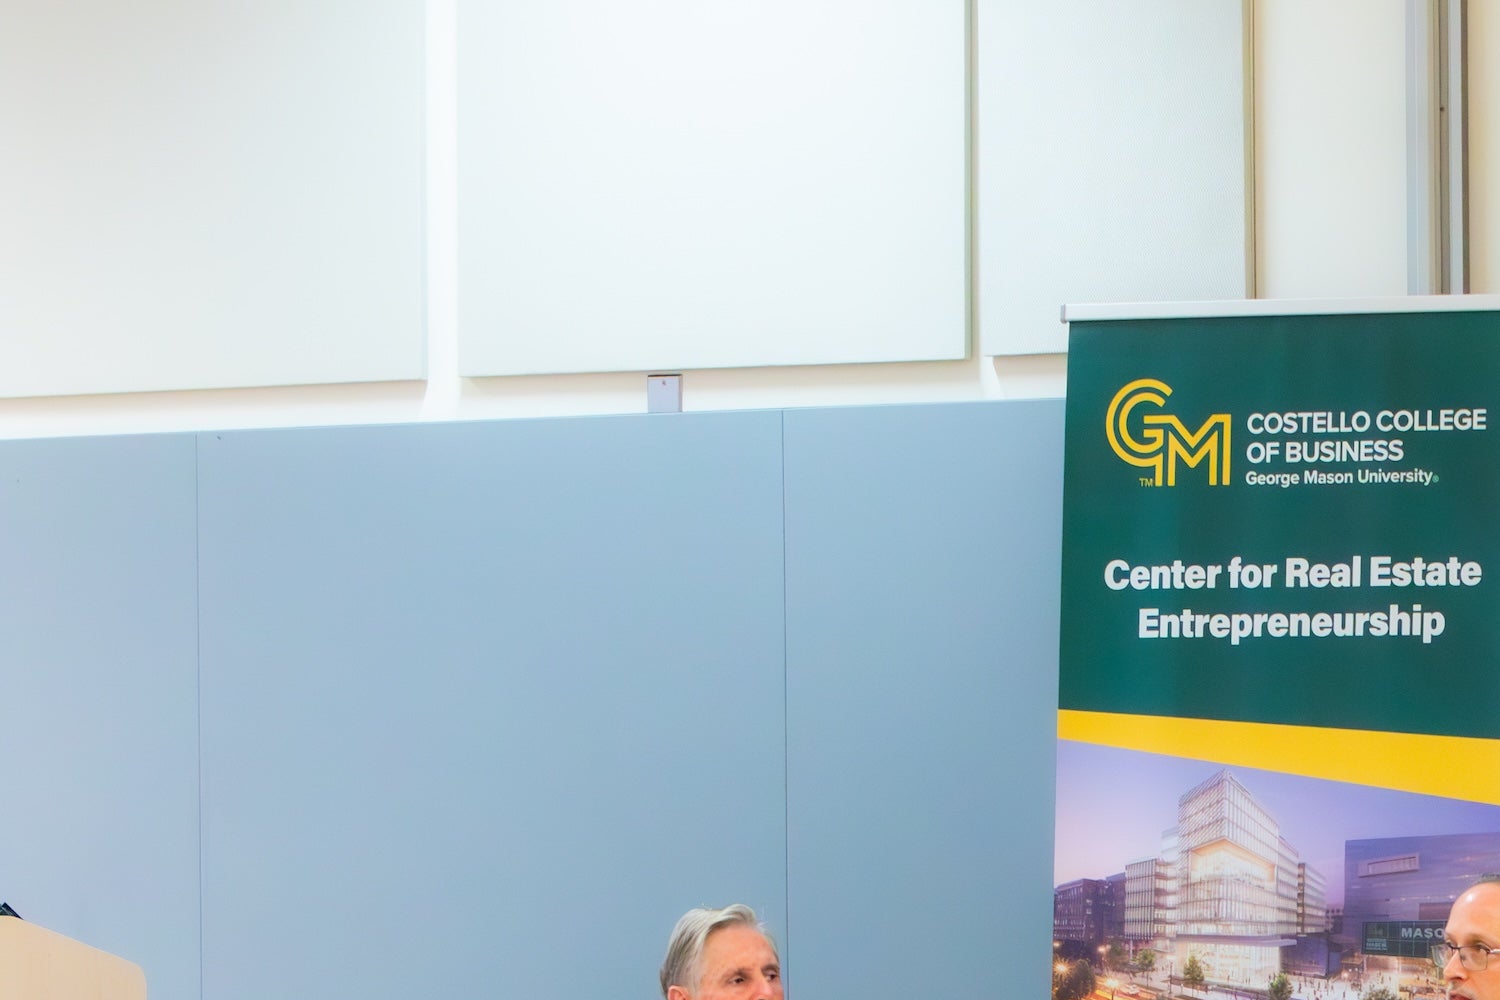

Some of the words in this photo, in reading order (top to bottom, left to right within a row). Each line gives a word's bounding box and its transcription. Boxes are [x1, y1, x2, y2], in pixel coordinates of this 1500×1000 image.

[1247, 411, 1371, 434] COSTELLO
[1376, 408, 1487, 432] COLLEGE
[1246, 442, 1280, 464] OF
[1285, 440, 1404, 463] BUSINESS
[1245, 470, 1300, 488] George
[1304, 469, 1353, 484] Mason
[1104, 559, 1222, 591] Center
[1227, 556, 1277, 589] for
[1285, 555, 1362, 588] Real
[1370, 556, 1483, 587] Estate
[1138, 604, 1446, 645] Entrepreneurship
[1401, 927, 1445, 939] MASO
